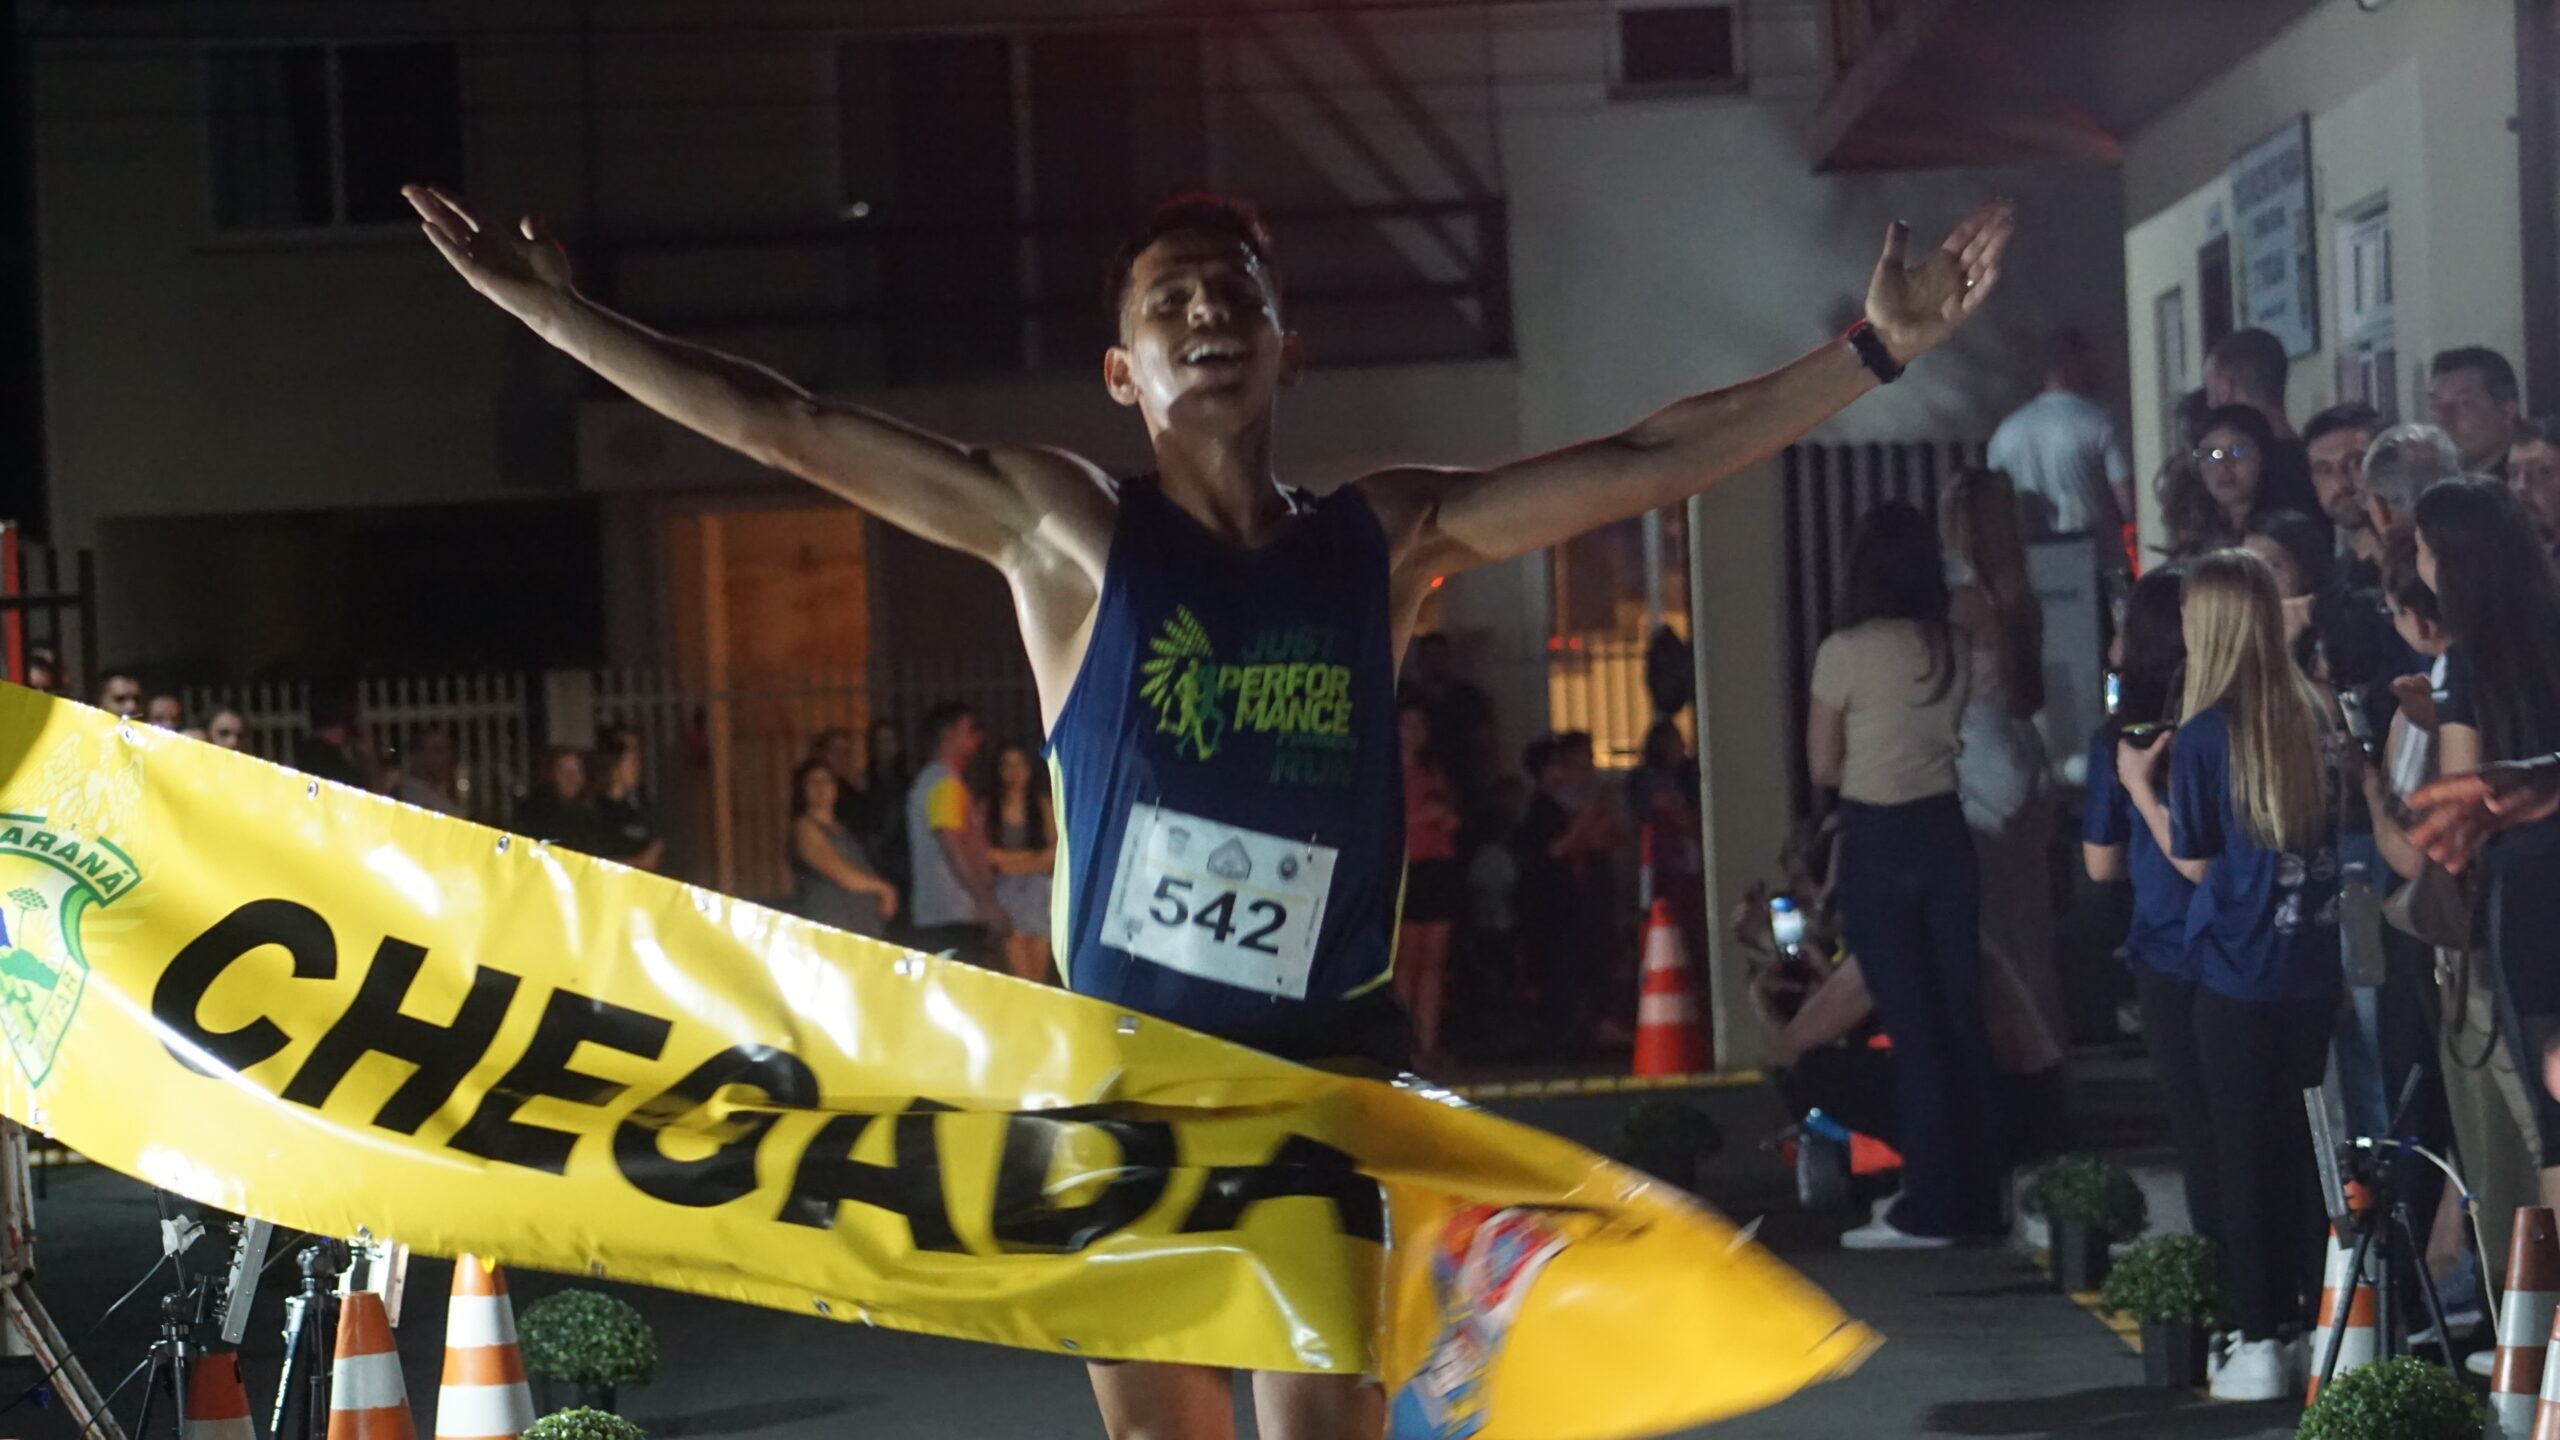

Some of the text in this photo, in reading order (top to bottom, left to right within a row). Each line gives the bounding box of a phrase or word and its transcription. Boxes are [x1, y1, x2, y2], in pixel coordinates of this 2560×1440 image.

[1217, 662, 1351, 702] PERFOR
[1232, 695, 1354, 735] MANCE
[1149, 876, 1287, 955] 542
[152, 898, 1391, 1256] CHEGADA
